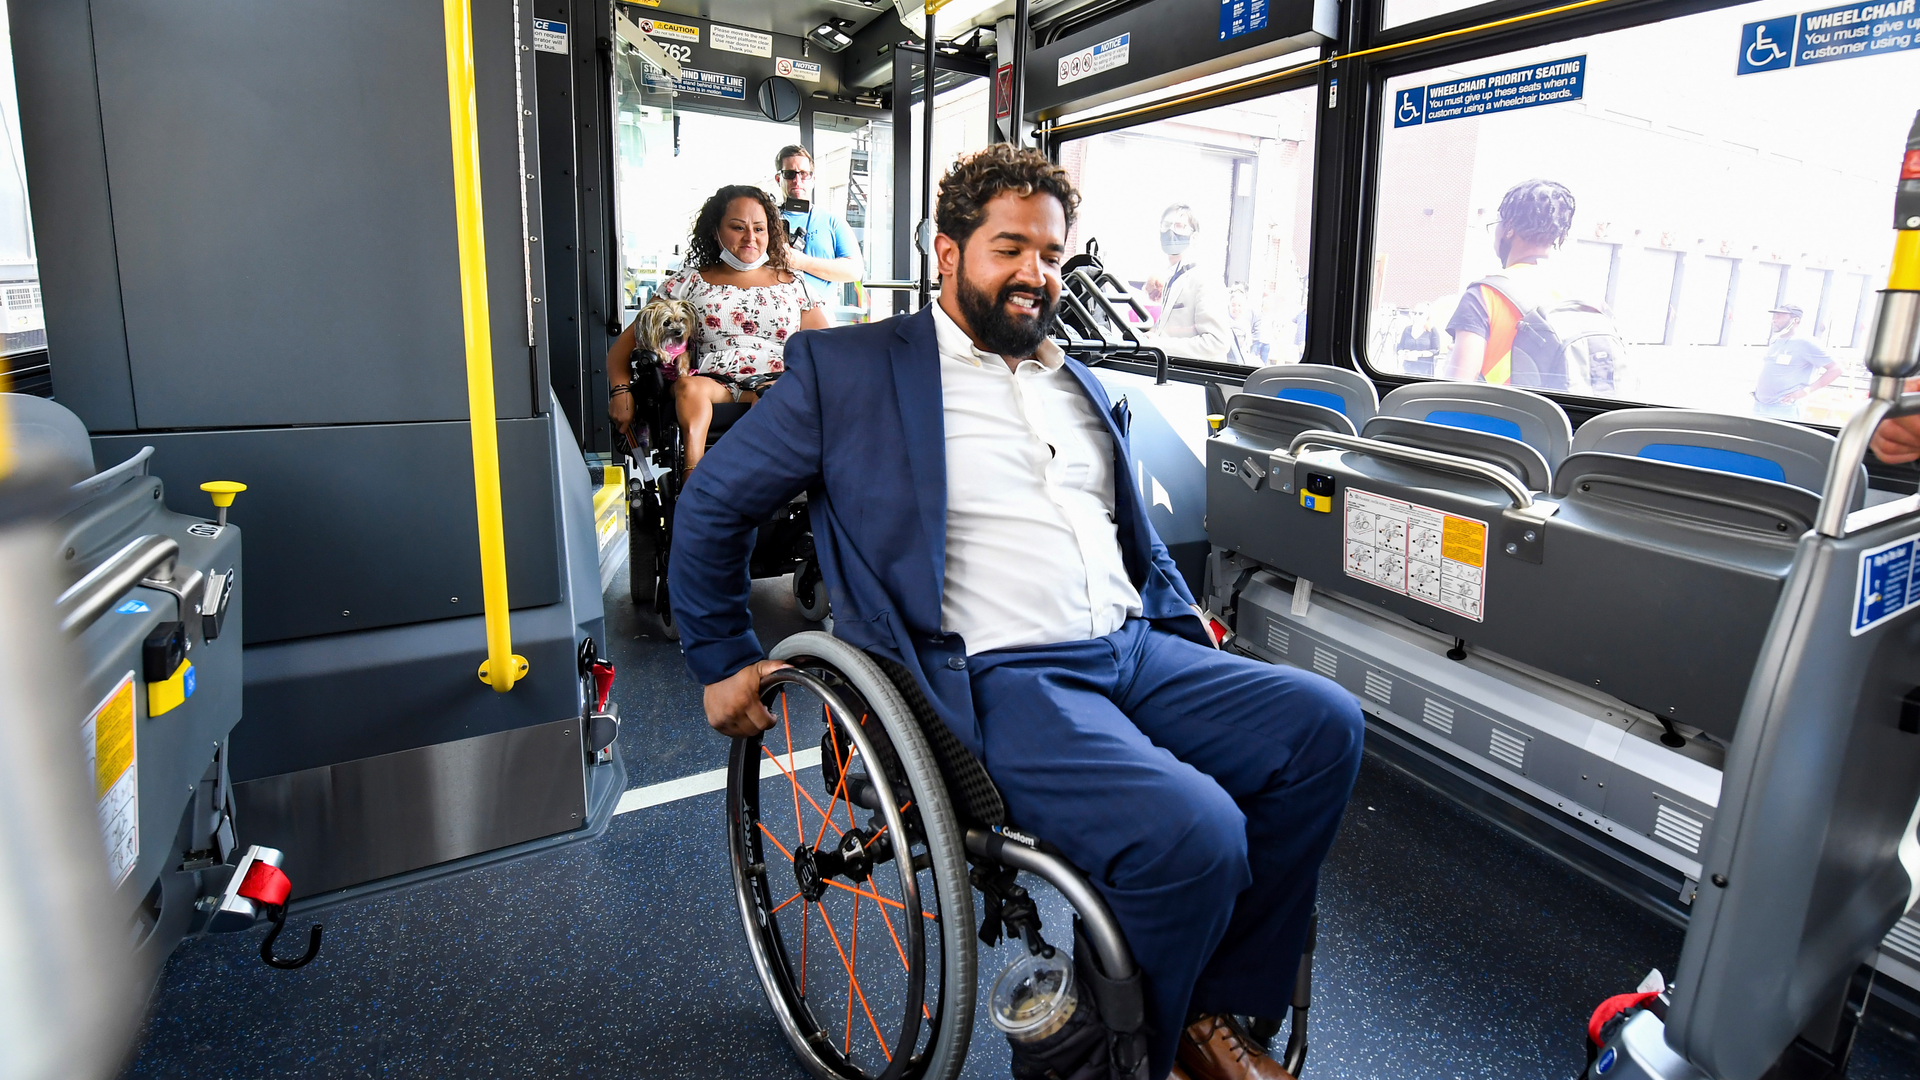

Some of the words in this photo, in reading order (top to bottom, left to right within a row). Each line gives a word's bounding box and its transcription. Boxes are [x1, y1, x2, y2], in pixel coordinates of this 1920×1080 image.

[1806, 0, 1916, 31] WHEELCHAIR
[664, 24, 695, 34] CAUTION
[1804, 33, 1831, 45] You
[1834, 24, 1870, 41] must
[1872, 20, 1904, 37] give
[654, 41, 691, 62] 762
[1100, 37, 1121, 52] NOTICE
[1801, 41, 1868, 60] customer
[1870, 34, 1911, 50] using
[795, 61, 818, 71] NOTICE
[681, 70, 699, 80] HIND
[700, 72, 725, 84] WHITE
[726, 76, 742, 87] LINE
[1430, 78, 1486, 99] WHEELCHAIR
[1488, 69, 1534, 88] PRIORITY
[1535, 61, 1580, 79] SEATING
[1428, 107, 1463, 119] customer
[1463, 103, 1484, 113] using
[1486, 102, 1492, 110] a
[1493, 93, 1537, 108] wheelchair
[1539, 88, 1572, 101] boards.
[1429, 99, 1443, 108] You
[1444, 95, 1463, 106] must
[1464, 93, 1480, 104] give
[1482, 91, 1493, 101] up
[1494, 87, 1517, 97] these
[1518, 81, 1541, 93] seats
[1543, 78, 1568, 89] when
[1569, 76, 1576, 85] a
[1002, 826, 1035, 846] Custom
